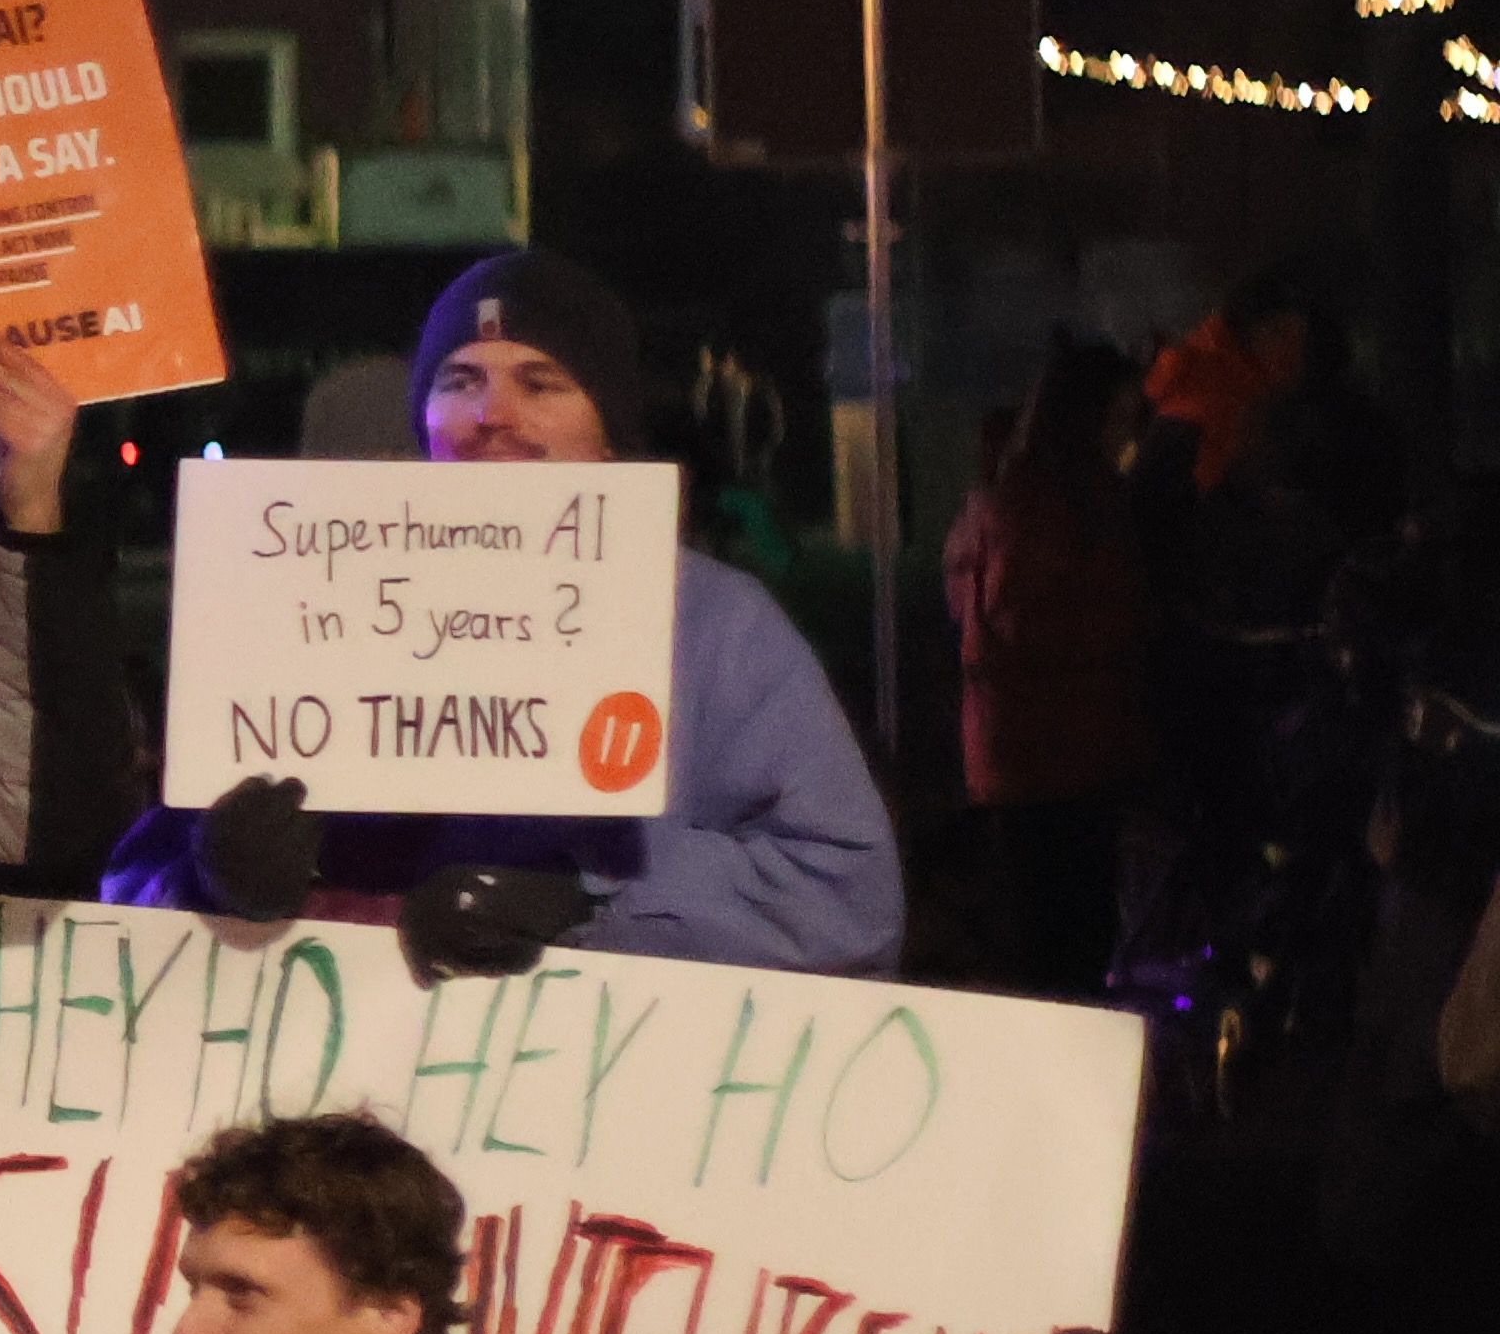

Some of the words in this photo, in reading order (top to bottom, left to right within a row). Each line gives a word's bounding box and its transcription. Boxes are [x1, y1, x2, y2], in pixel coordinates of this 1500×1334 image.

[27, 128, 116, 175] SAY.
[3, 302, 144, 348] AUSEAI
[252, 501, 522, 581] Superhuman
[544, 493, 607, 562] AI
[300, 602, 343, 644] in
[371, 577, 410, 636] 5
[231, 694, 332, 763] NO
[359, 694, 548, 759] THANKS
[187, 937, 345, 1132] HO
[401, 967, 660, 1169] HEY
[694, 989, 940, 1187] HO
